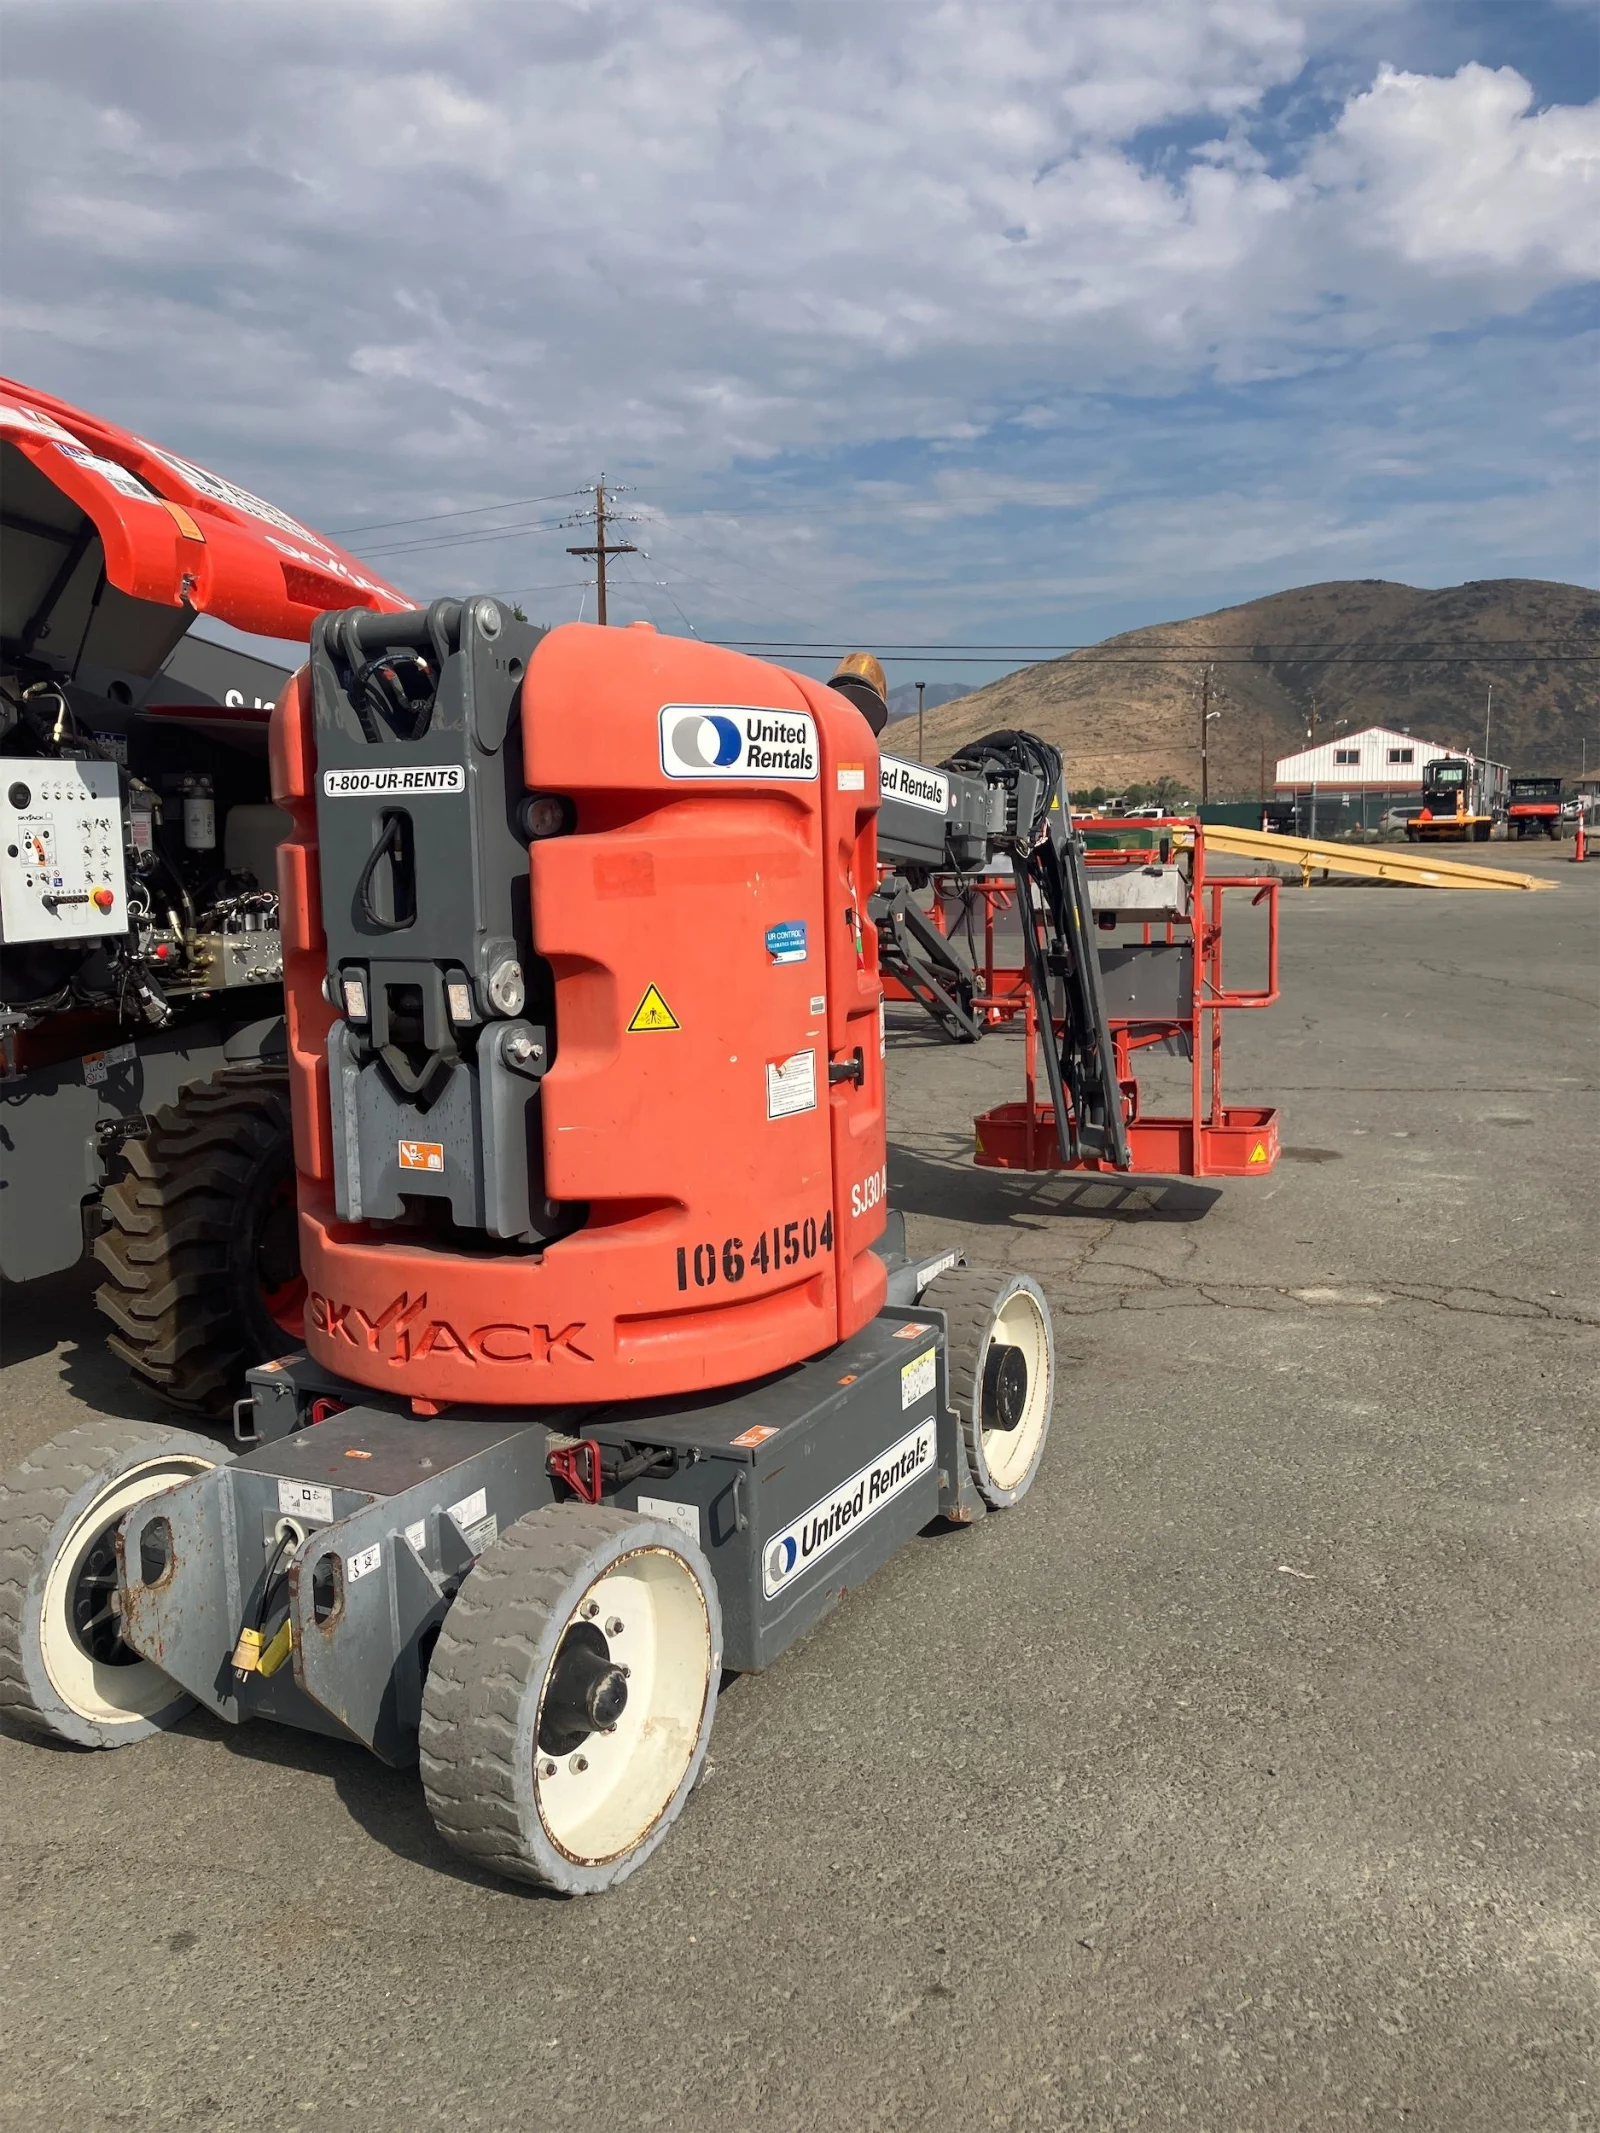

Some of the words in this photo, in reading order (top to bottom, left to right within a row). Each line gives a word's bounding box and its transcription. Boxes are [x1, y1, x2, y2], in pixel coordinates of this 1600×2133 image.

[746, 718, 806, 744] United
[746, 745, 812, 770] Rentals
[328, 770, 459, 791] 1-800-UR-RENTS
[900, 770, 942, 804] Rentals
[851, 1171, 880, 1217] SJ30
[676, 1209, 833, 1291] 10641504
[311, 1290, 595, 1368] SKYJACK
[801, 1480, 865, 1557] United
[868, 1435, 928, 1505] Rentals
